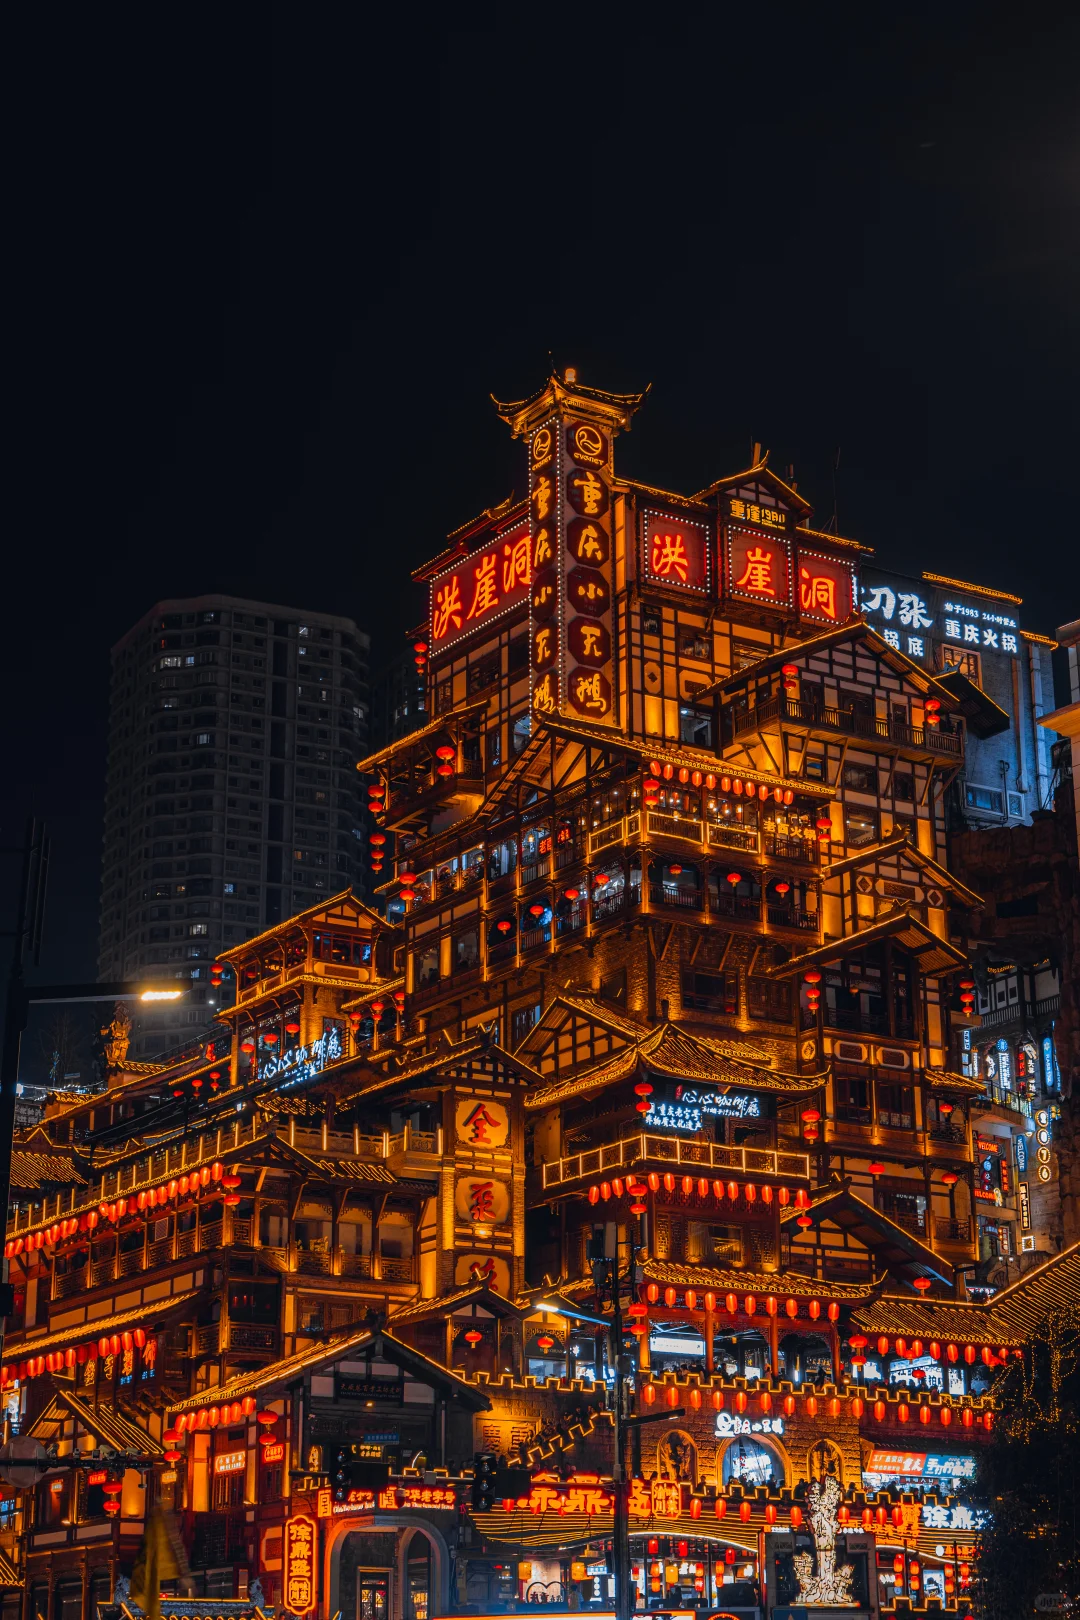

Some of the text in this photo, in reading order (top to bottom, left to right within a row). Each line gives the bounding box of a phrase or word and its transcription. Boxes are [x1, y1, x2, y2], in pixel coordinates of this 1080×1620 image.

[433, 535, 531, 640] 洪崖洞
[573, 473, 607, 711] 重庆小天鹅
[652, 533, 837, 618] 洪崖洞
[531, 476, 556, 712] 重庆小天鹅
[945, 619, 1017, 653] 重庆火锅
[645, 1113, 702, 1131] 非物质文化遗产
[657, 1103, 701, 1121] 重庆老字号
[978, 1140, 999, 1153] WELCOME
[1017, 1138, 1026, 1170] WELCOME
[922, 1506, 992, 1530] 徐鼎
[289, 1523, 312, 1577] 徐鼎盛
